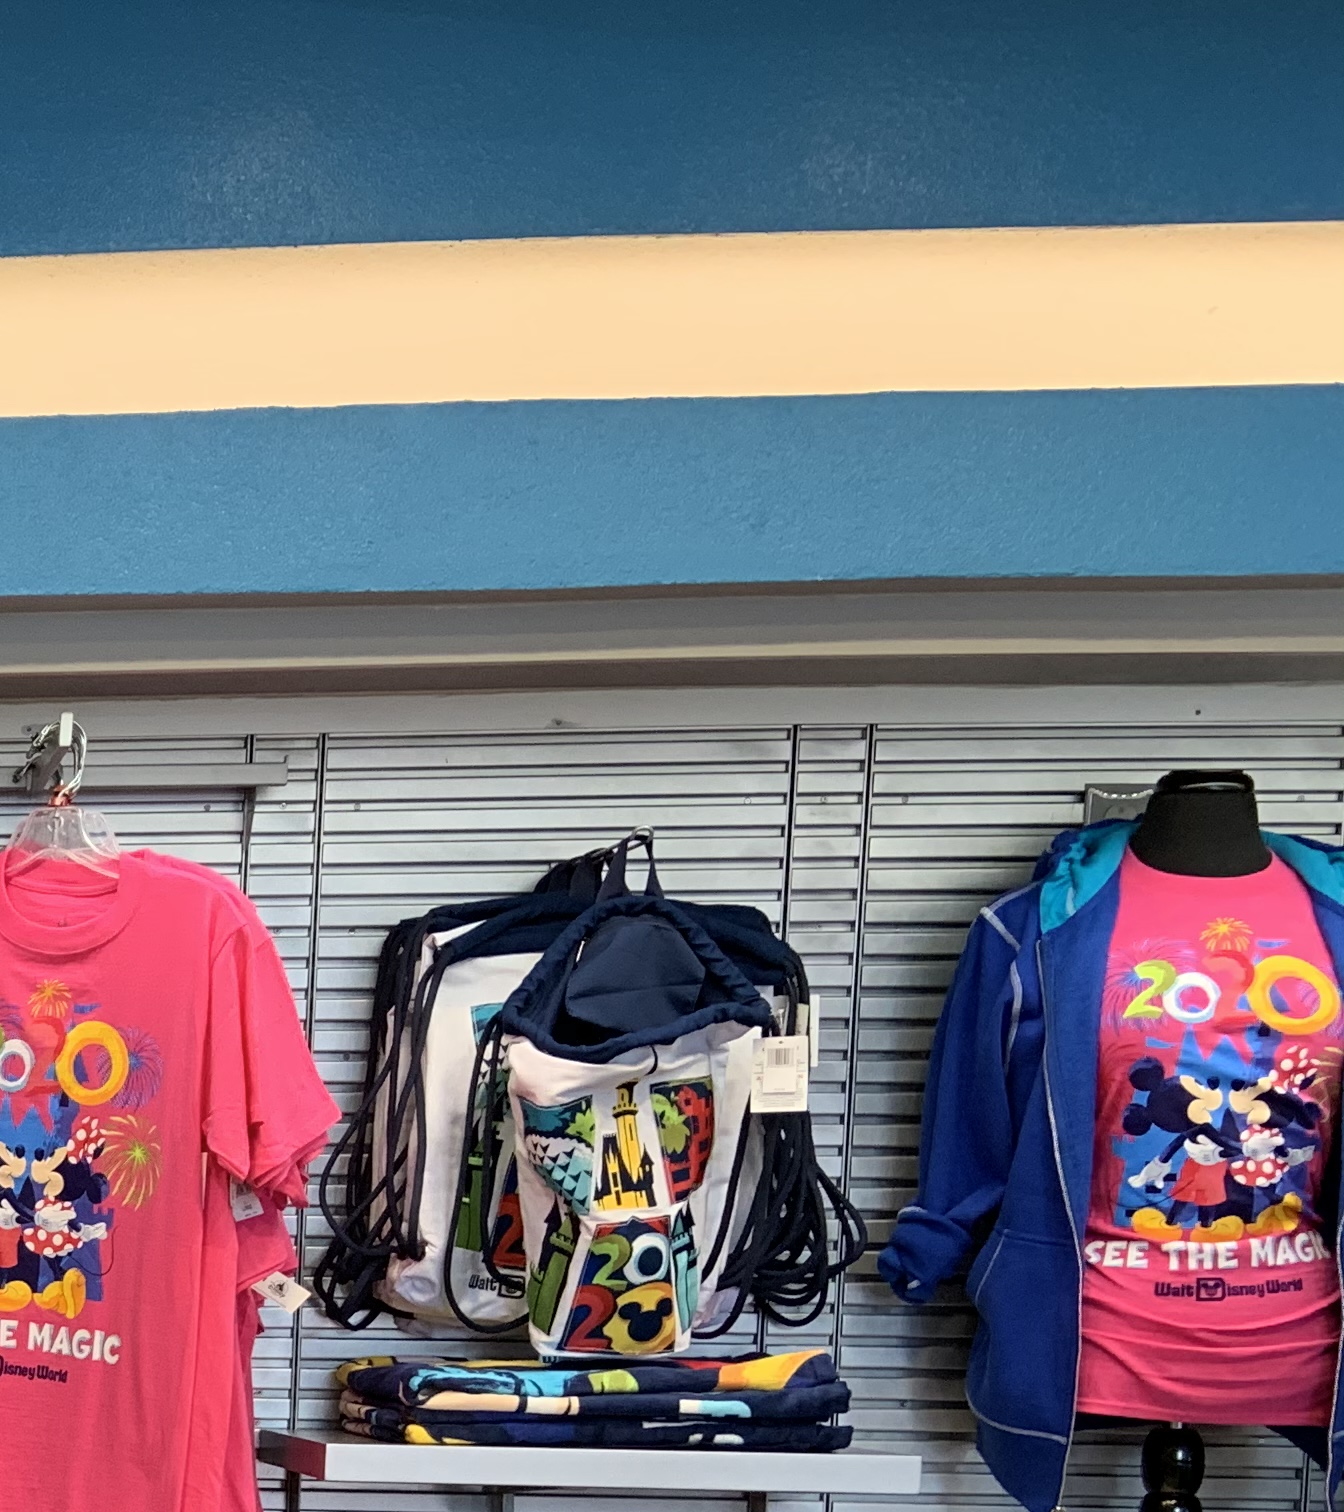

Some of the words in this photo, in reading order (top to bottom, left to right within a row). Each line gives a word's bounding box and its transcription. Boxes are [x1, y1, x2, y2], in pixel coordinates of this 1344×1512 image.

[1085, 1240, 1149, 1269] SEE
[1161, 1240, 1239, 1271] THE
[468, 1273, 497, 1292] Walt
[1154, 1281, 1194, 1297] Walt
[1195, 1277, 1265, 1302] Disney
[1266, 1278, 1303, 1294] World
[27, 1320, 122, 1365] MAGIC
[37, 1364, 68, 1384] World
